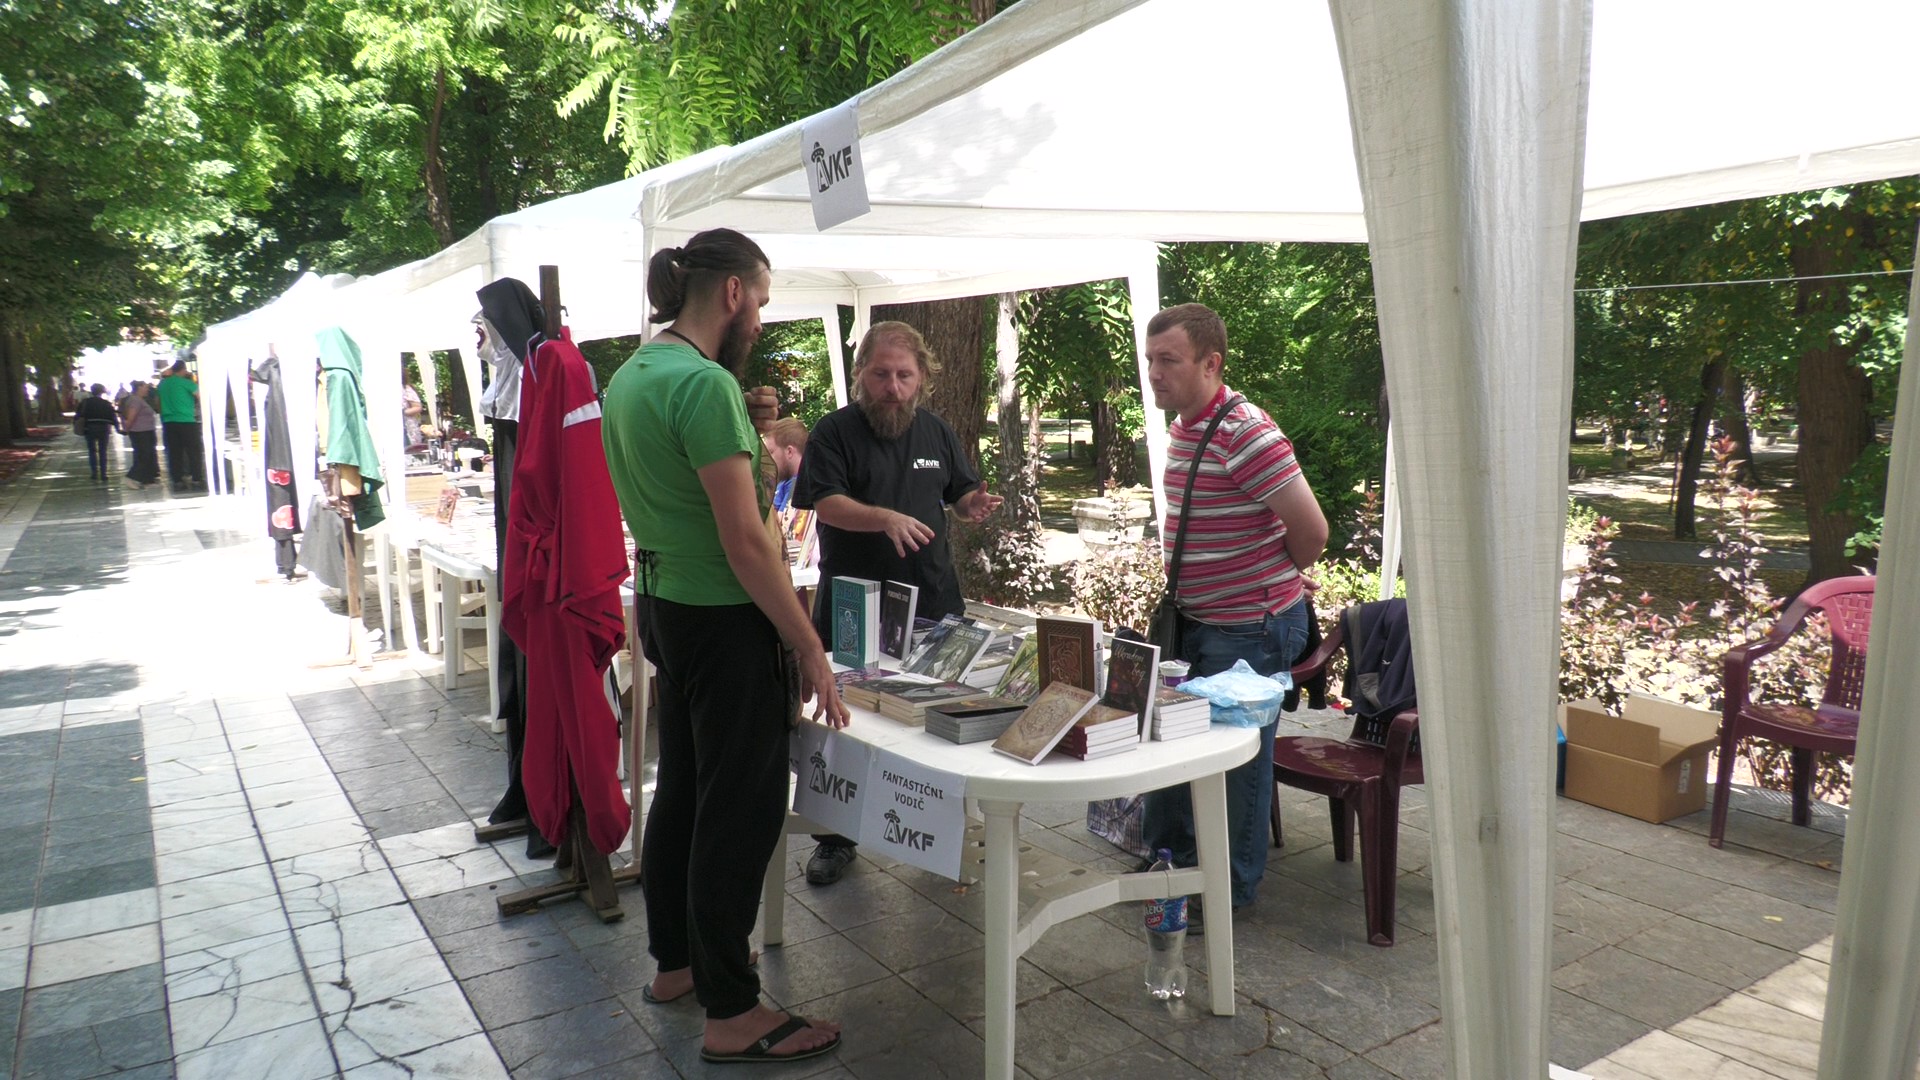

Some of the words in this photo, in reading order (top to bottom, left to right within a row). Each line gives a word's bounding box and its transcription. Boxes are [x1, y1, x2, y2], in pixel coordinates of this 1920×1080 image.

[812, 144, 853, 193] AVKF
[809, 760, 858, 804] AVKF
[882, 770, 944, 800] FANTASTIČNI
[894, 791, 925, 811] VODIČ
[883, 816, 935, 852] AVKF
